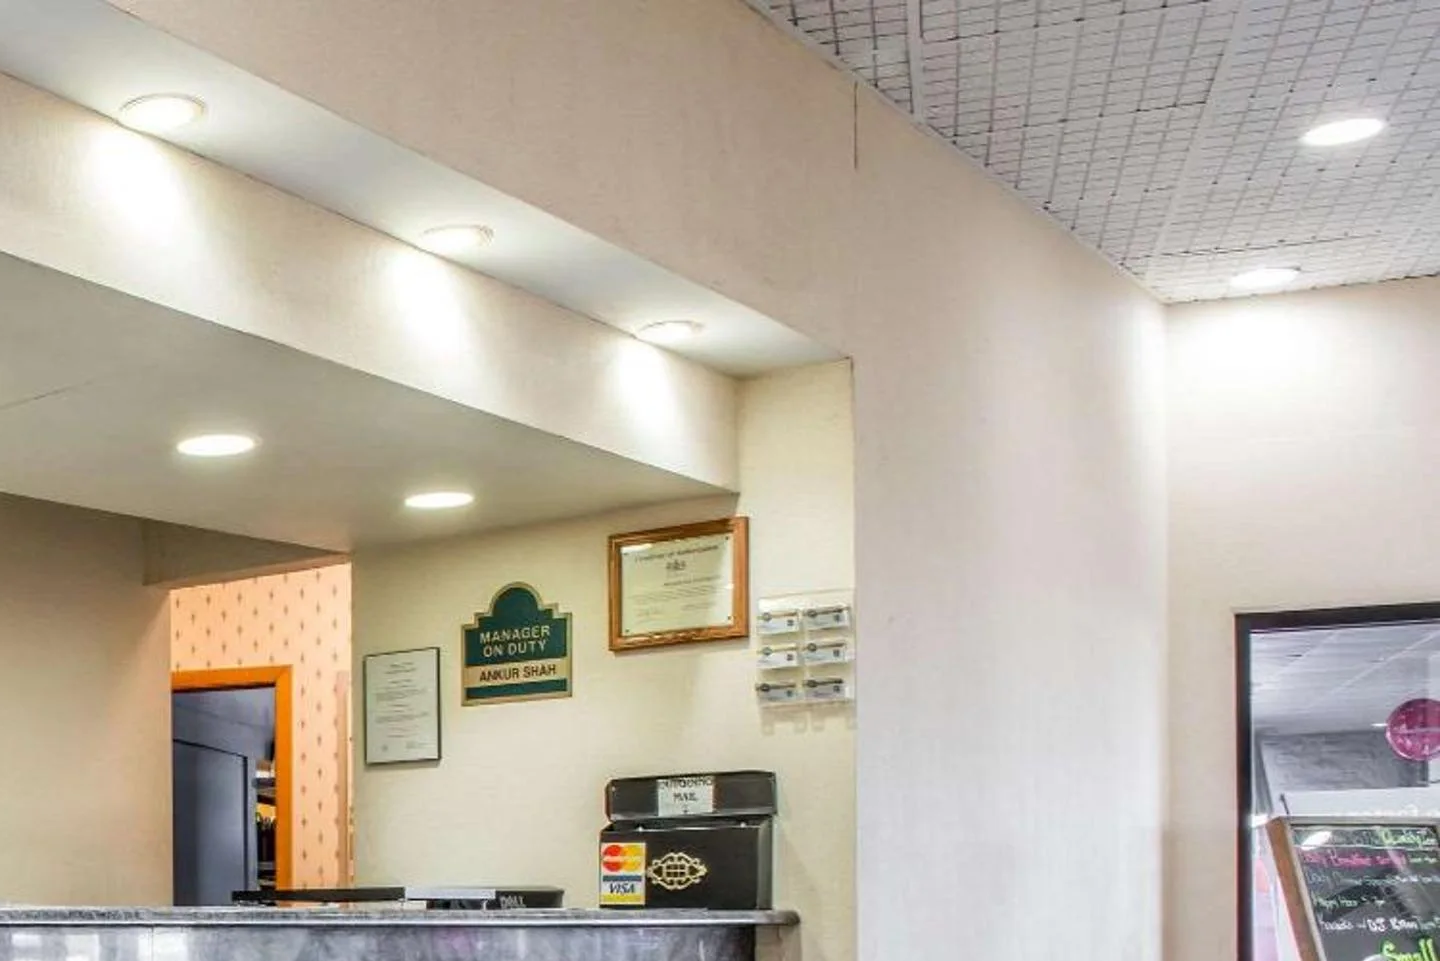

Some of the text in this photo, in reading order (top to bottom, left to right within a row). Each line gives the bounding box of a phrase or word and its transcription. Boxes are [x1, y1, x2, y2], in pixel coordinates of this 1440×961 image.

[479, 625, 551, 644] MANAGER
[482, 640, 547, 658] ON DUTY
[479, 663, 557, 682] ANKUR SHAH
[608, 883, 636, 895] VISA
